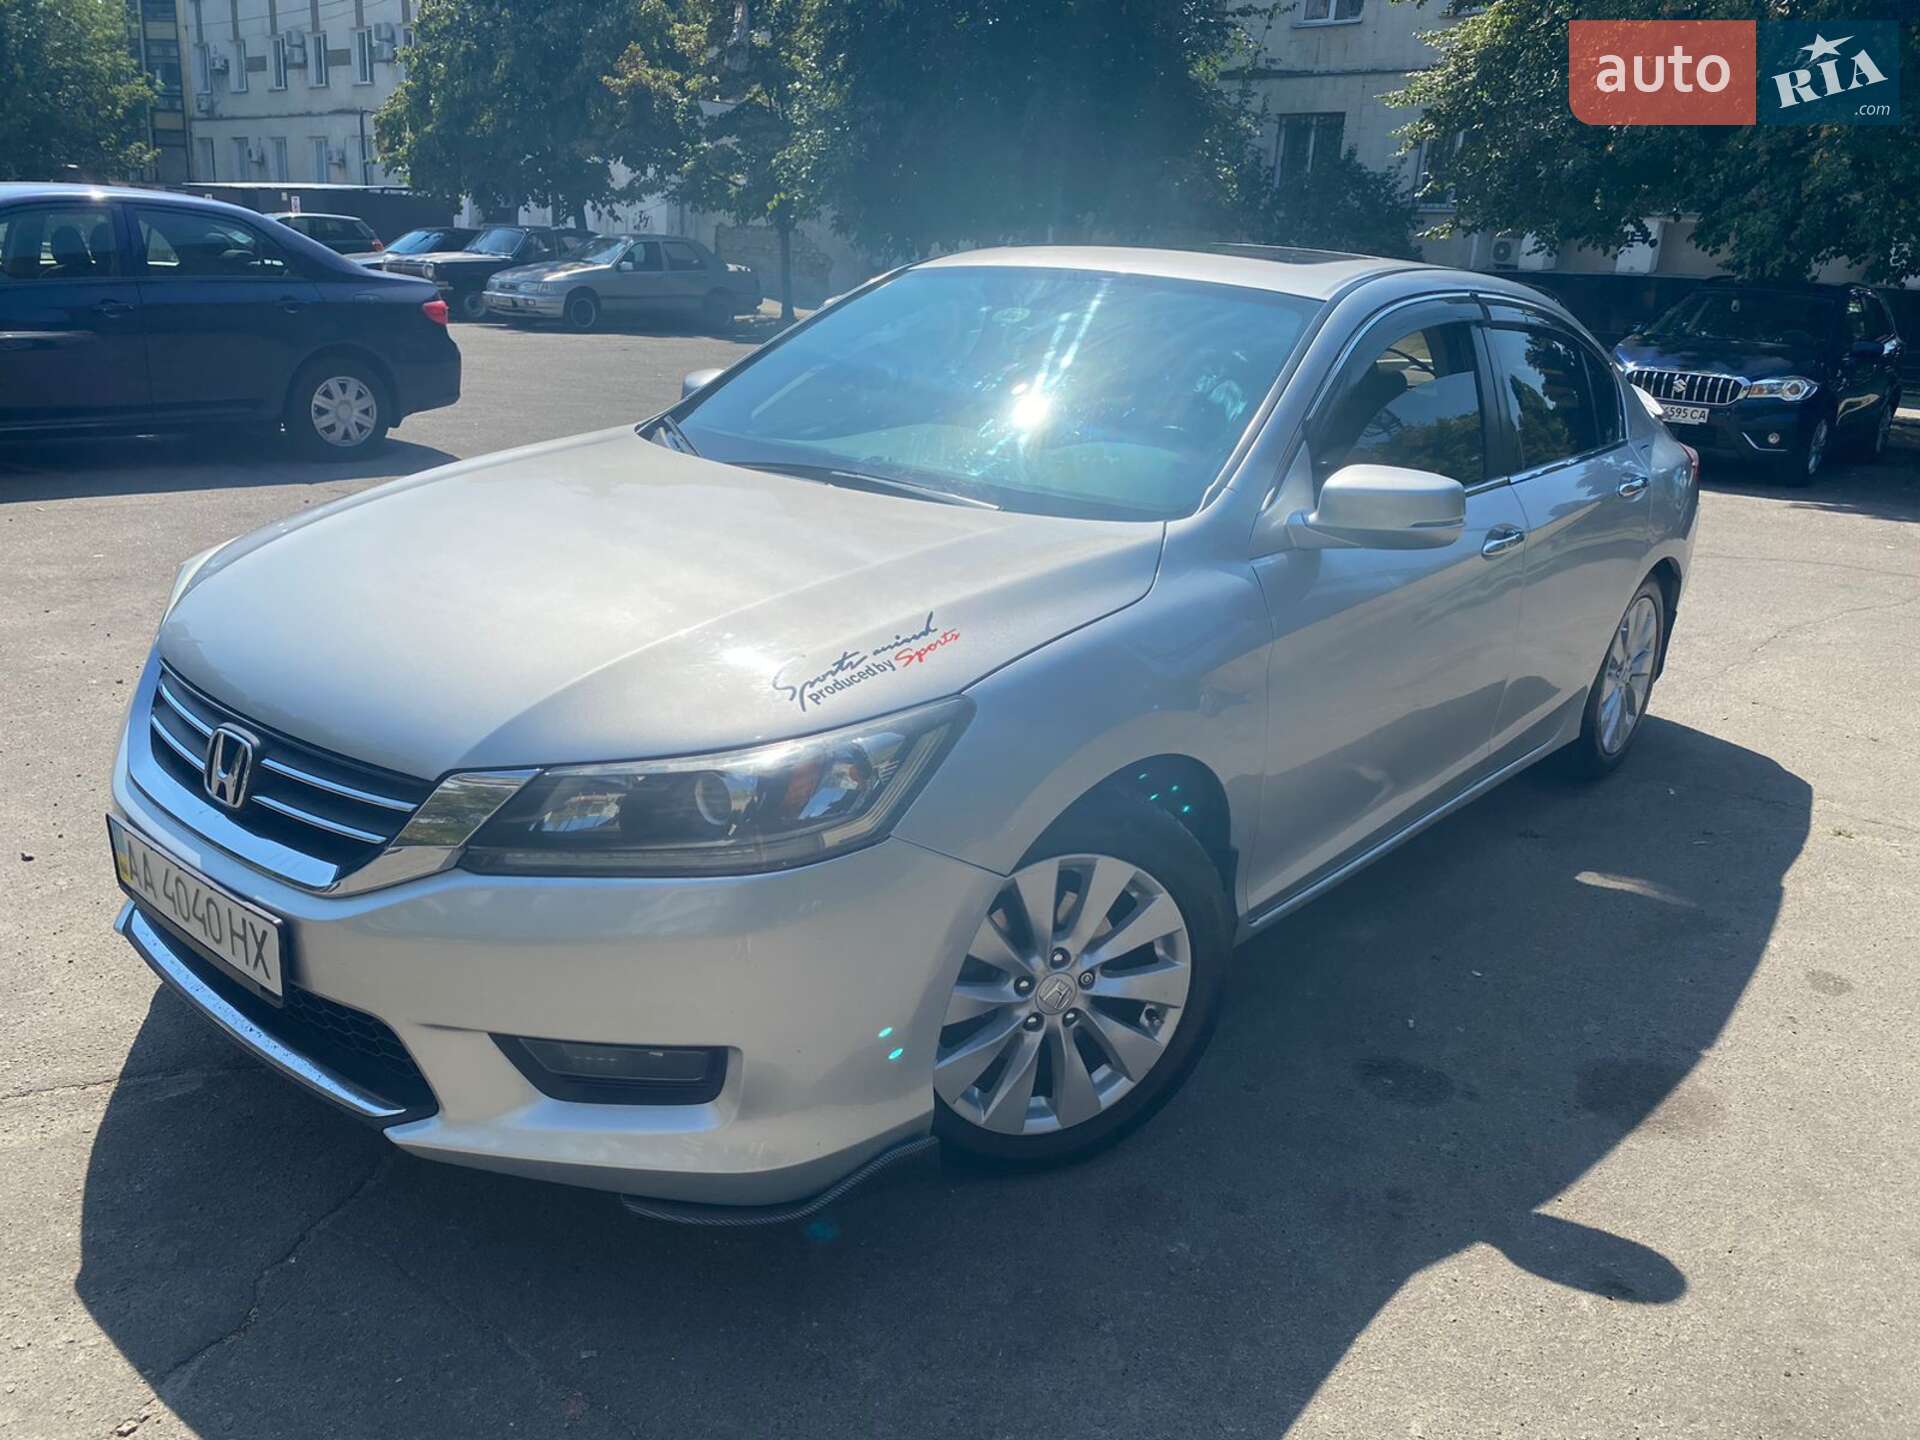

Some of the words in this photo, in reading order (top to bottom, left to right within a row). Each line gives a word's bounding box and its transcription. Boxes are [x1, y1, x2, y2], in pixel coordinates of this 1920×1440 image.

[1690, 409, 1706, 420] CA
[894, 628, 961, 668] Sports
[127, 840, 158, 899] AA
[163, 868, 223, 945] 4040
[228, 908, 272, 981] HX
